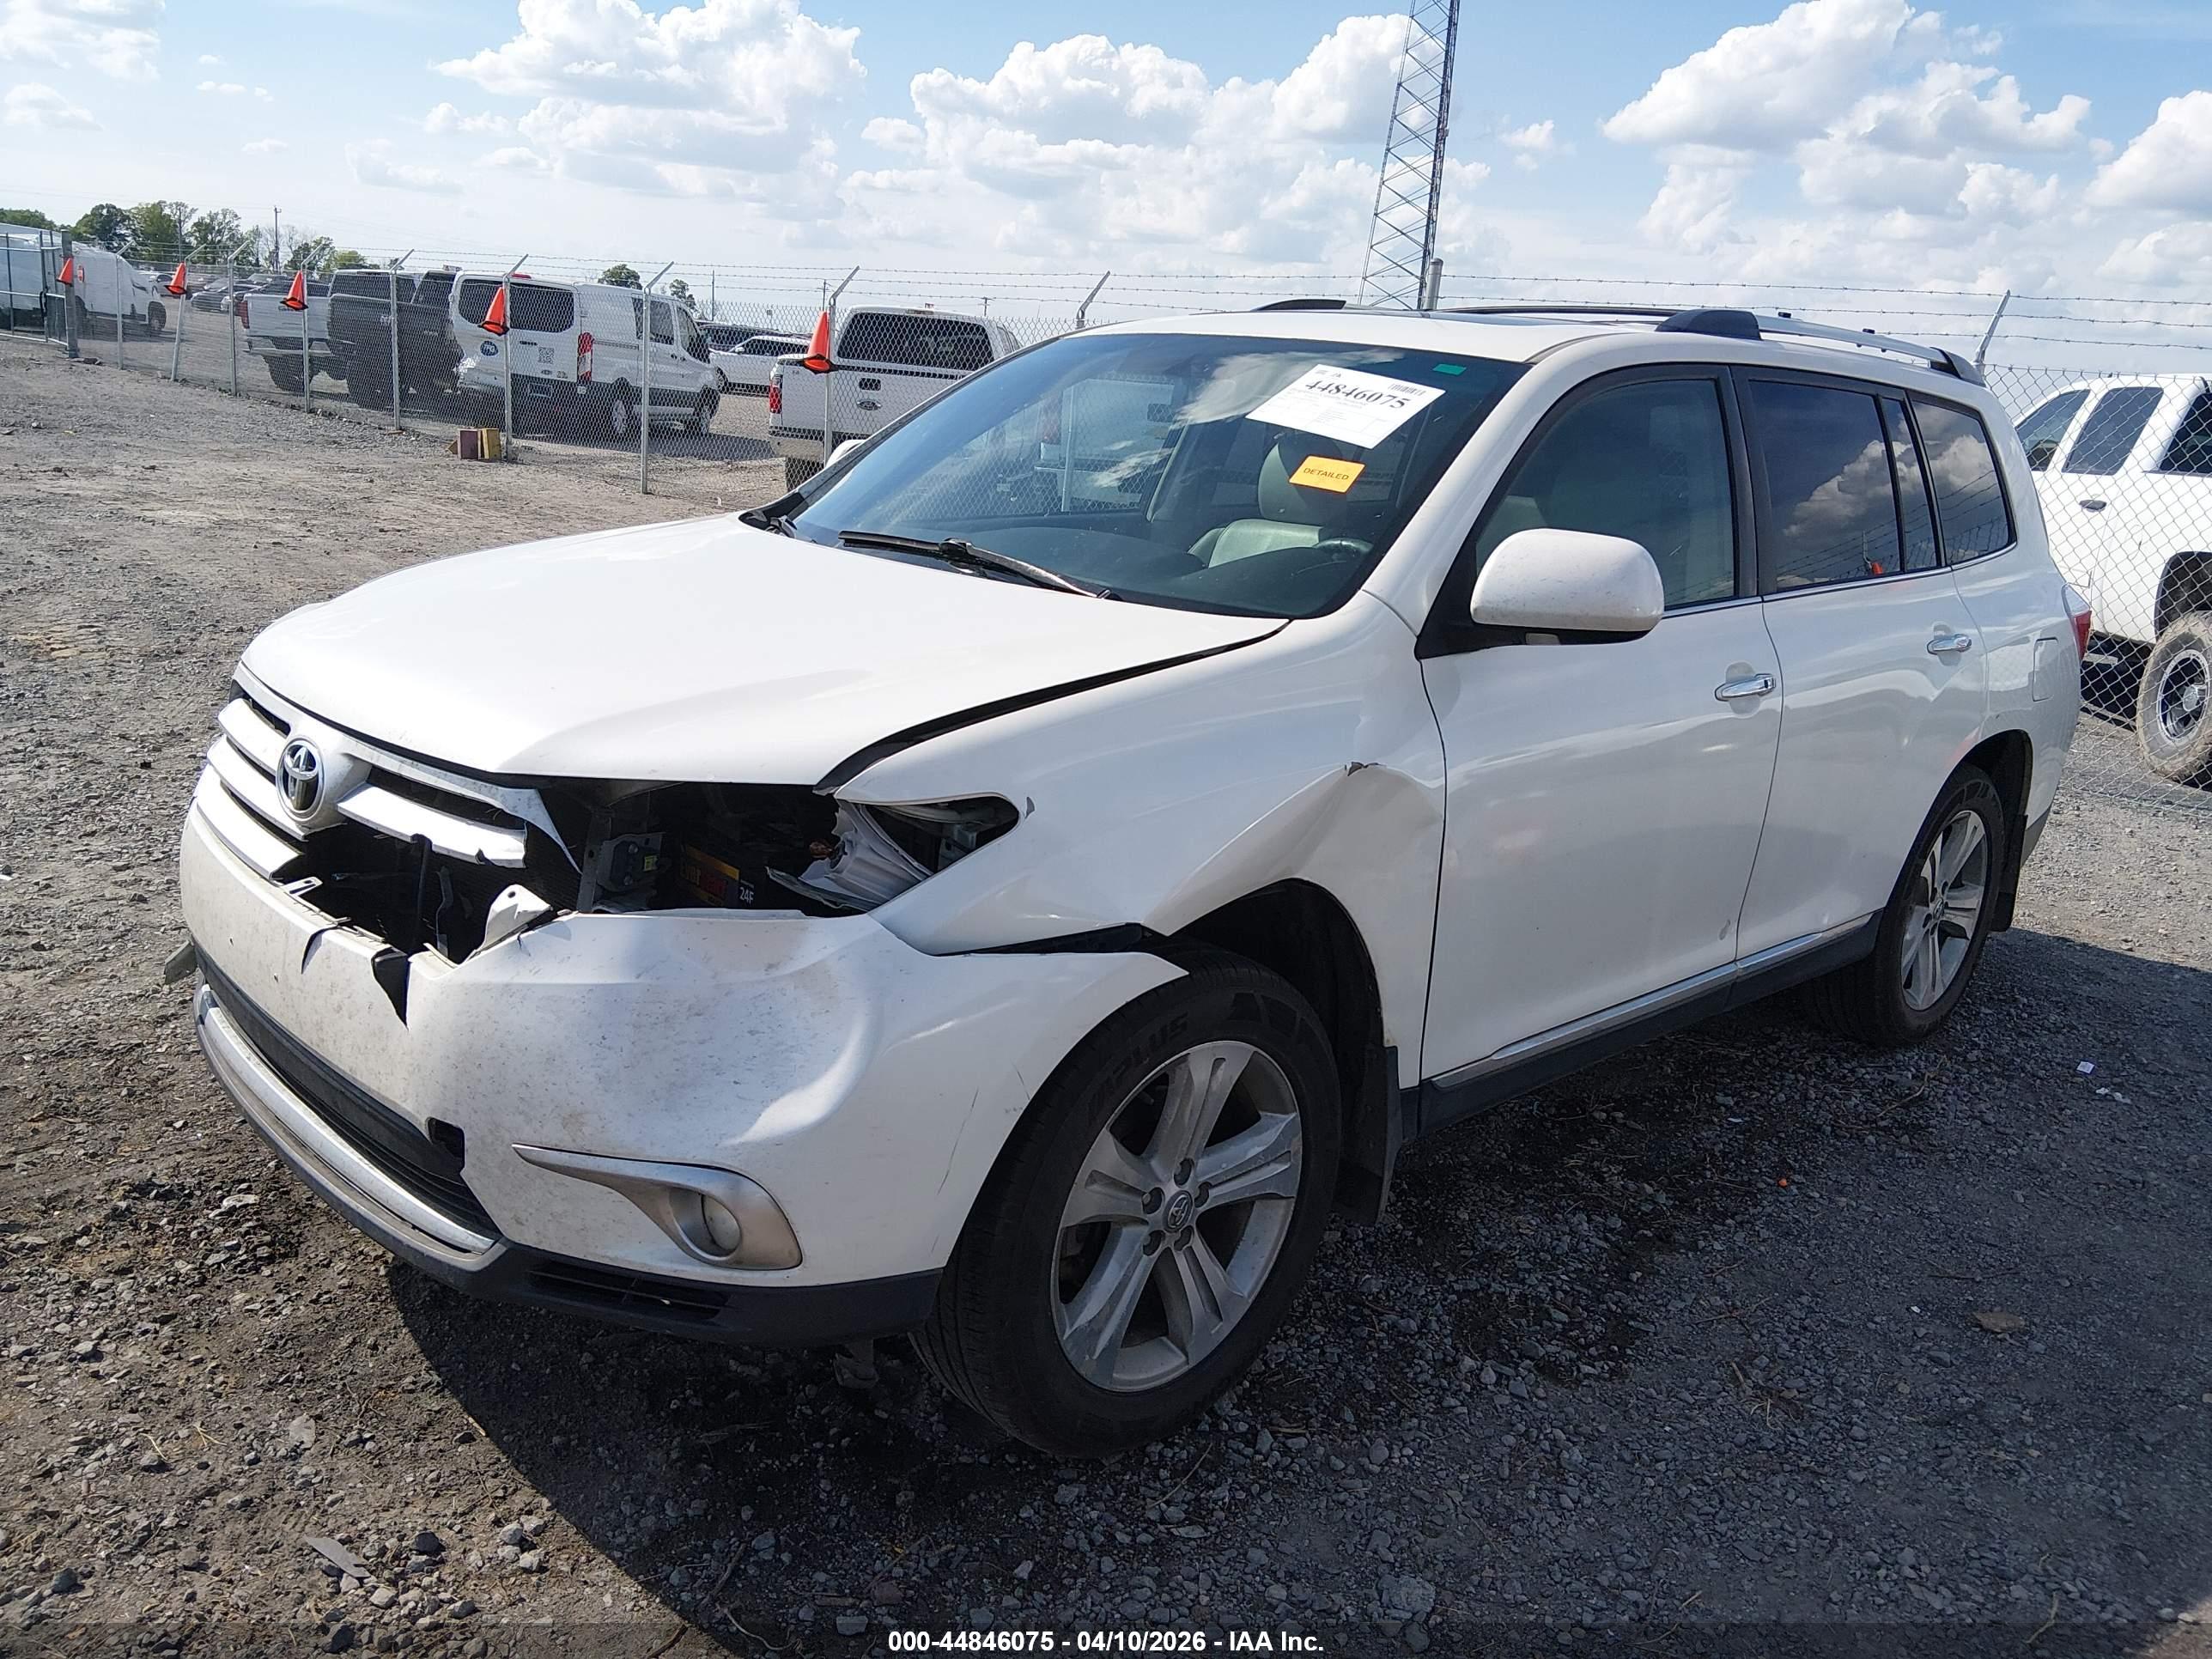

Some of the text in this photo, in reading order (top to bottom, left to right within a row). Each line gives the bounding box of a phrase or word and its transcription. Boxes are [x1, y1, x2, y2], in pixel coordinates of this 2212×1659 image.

[1304, 380, 1411, 409] 44846075
[1303, 466, 1349, 481] DETAILED
[739, 887, 755, 905] 24F
